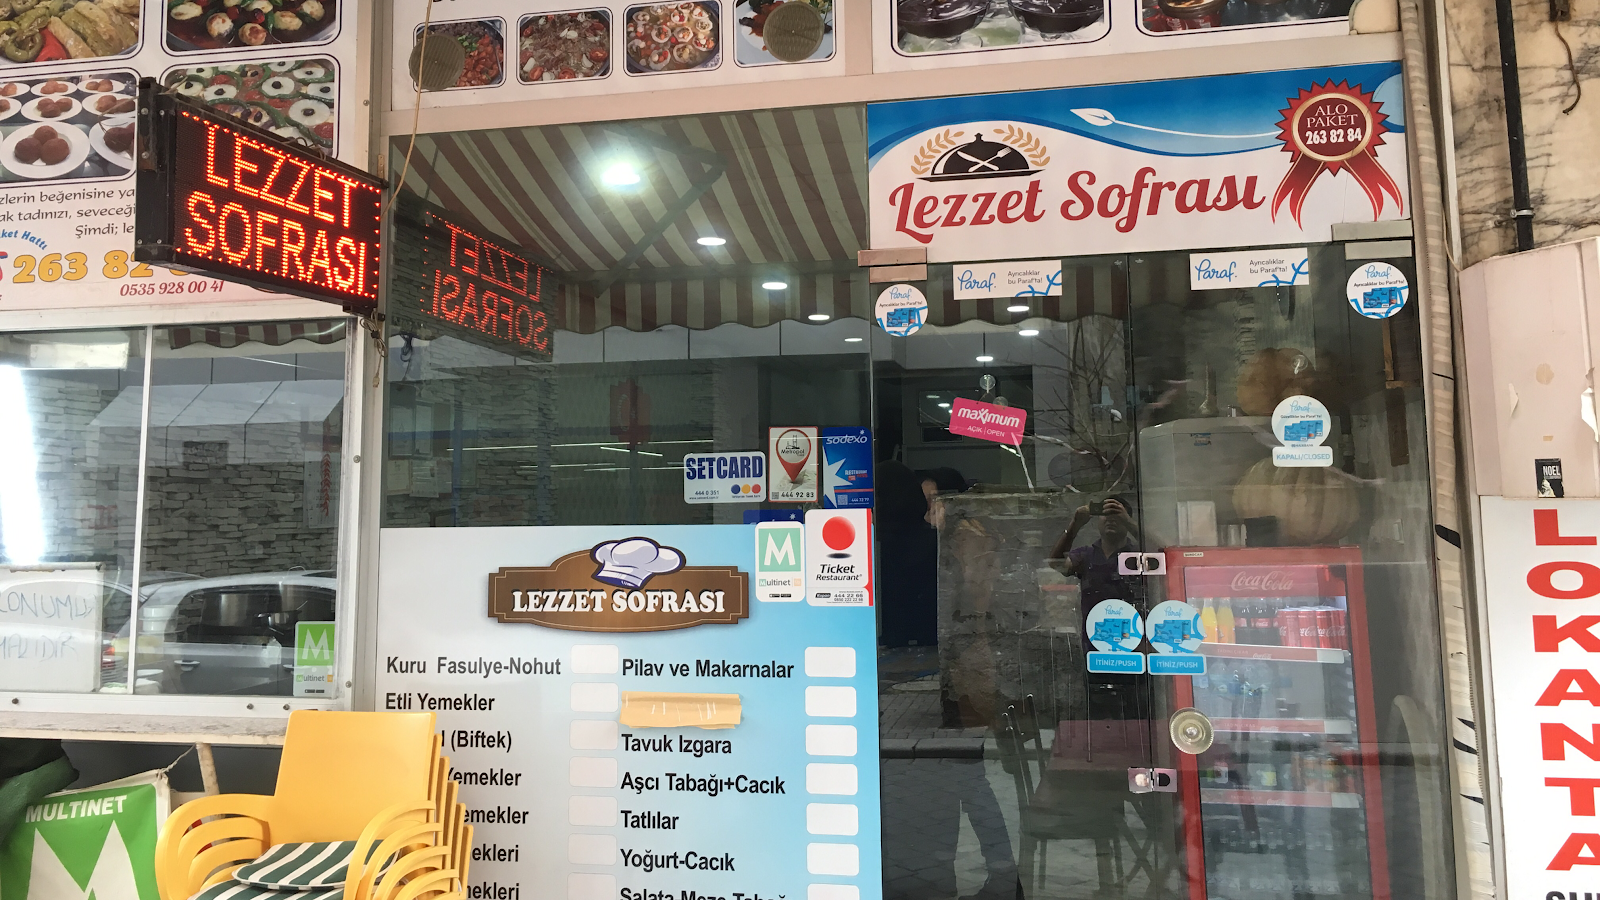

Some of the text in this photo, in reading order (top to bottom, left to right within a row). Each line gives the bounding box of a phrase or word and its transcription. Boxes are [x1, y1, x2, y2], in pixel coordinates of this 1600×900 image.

[1315, 104, 1348, 116] ALO
[1307, 114, 1358, 128] PAKET
[1306, 128, 1362, 144] 263 82 84
[207, 124, 357, 228] LEZZET
[40, 188, 114, 204] beğenisine
[118, 189, 135, 199] ya
[888, 166, 1266, 244] Lezzet Sofrası
[18, 208, 72, 221] tadınızı,
[77, 204, 135, 217] seveceği
[0, 229, 47, 250] ket Hattı
[75, 223, 134, 239] Şimdi; le
[184, 190, 366, 296] SOFRASI
[13, 252, 88, 283] 263
[120, 280, 224, 296] 0535 928 00 41
[958, 408, 1019, 427] maximum
[825, 434, 868, 445] sodexo
[967, 425, 1005, 437] AÇIK OPEN
[686, 455, 763, 480] SETCARD
[1543, 465, 1560, 476] NOEL
[820, 564, 855, 574] Ticket
[512, 590, 725, 613] LEZZET SOFRASI
[386, 656, 561, 678] Kuru Fasulye-Nohut
[622, 658, 794, 678] Pilav ve Makarnalar
[385, 692, 495, 711] Etli Yemekler
[451, 730, 512, 752] (Biftek)
[621, 734, 732, 757] Tavuk Izgara
[620, 772, 785, 797] Aşcı Tabağı+Cacık
[25, 795, 127, 823] MULTINET
[620, 810, 679, 829] Tatlılar
[620, 848, 735, 872] Yoğurt-Cacık
